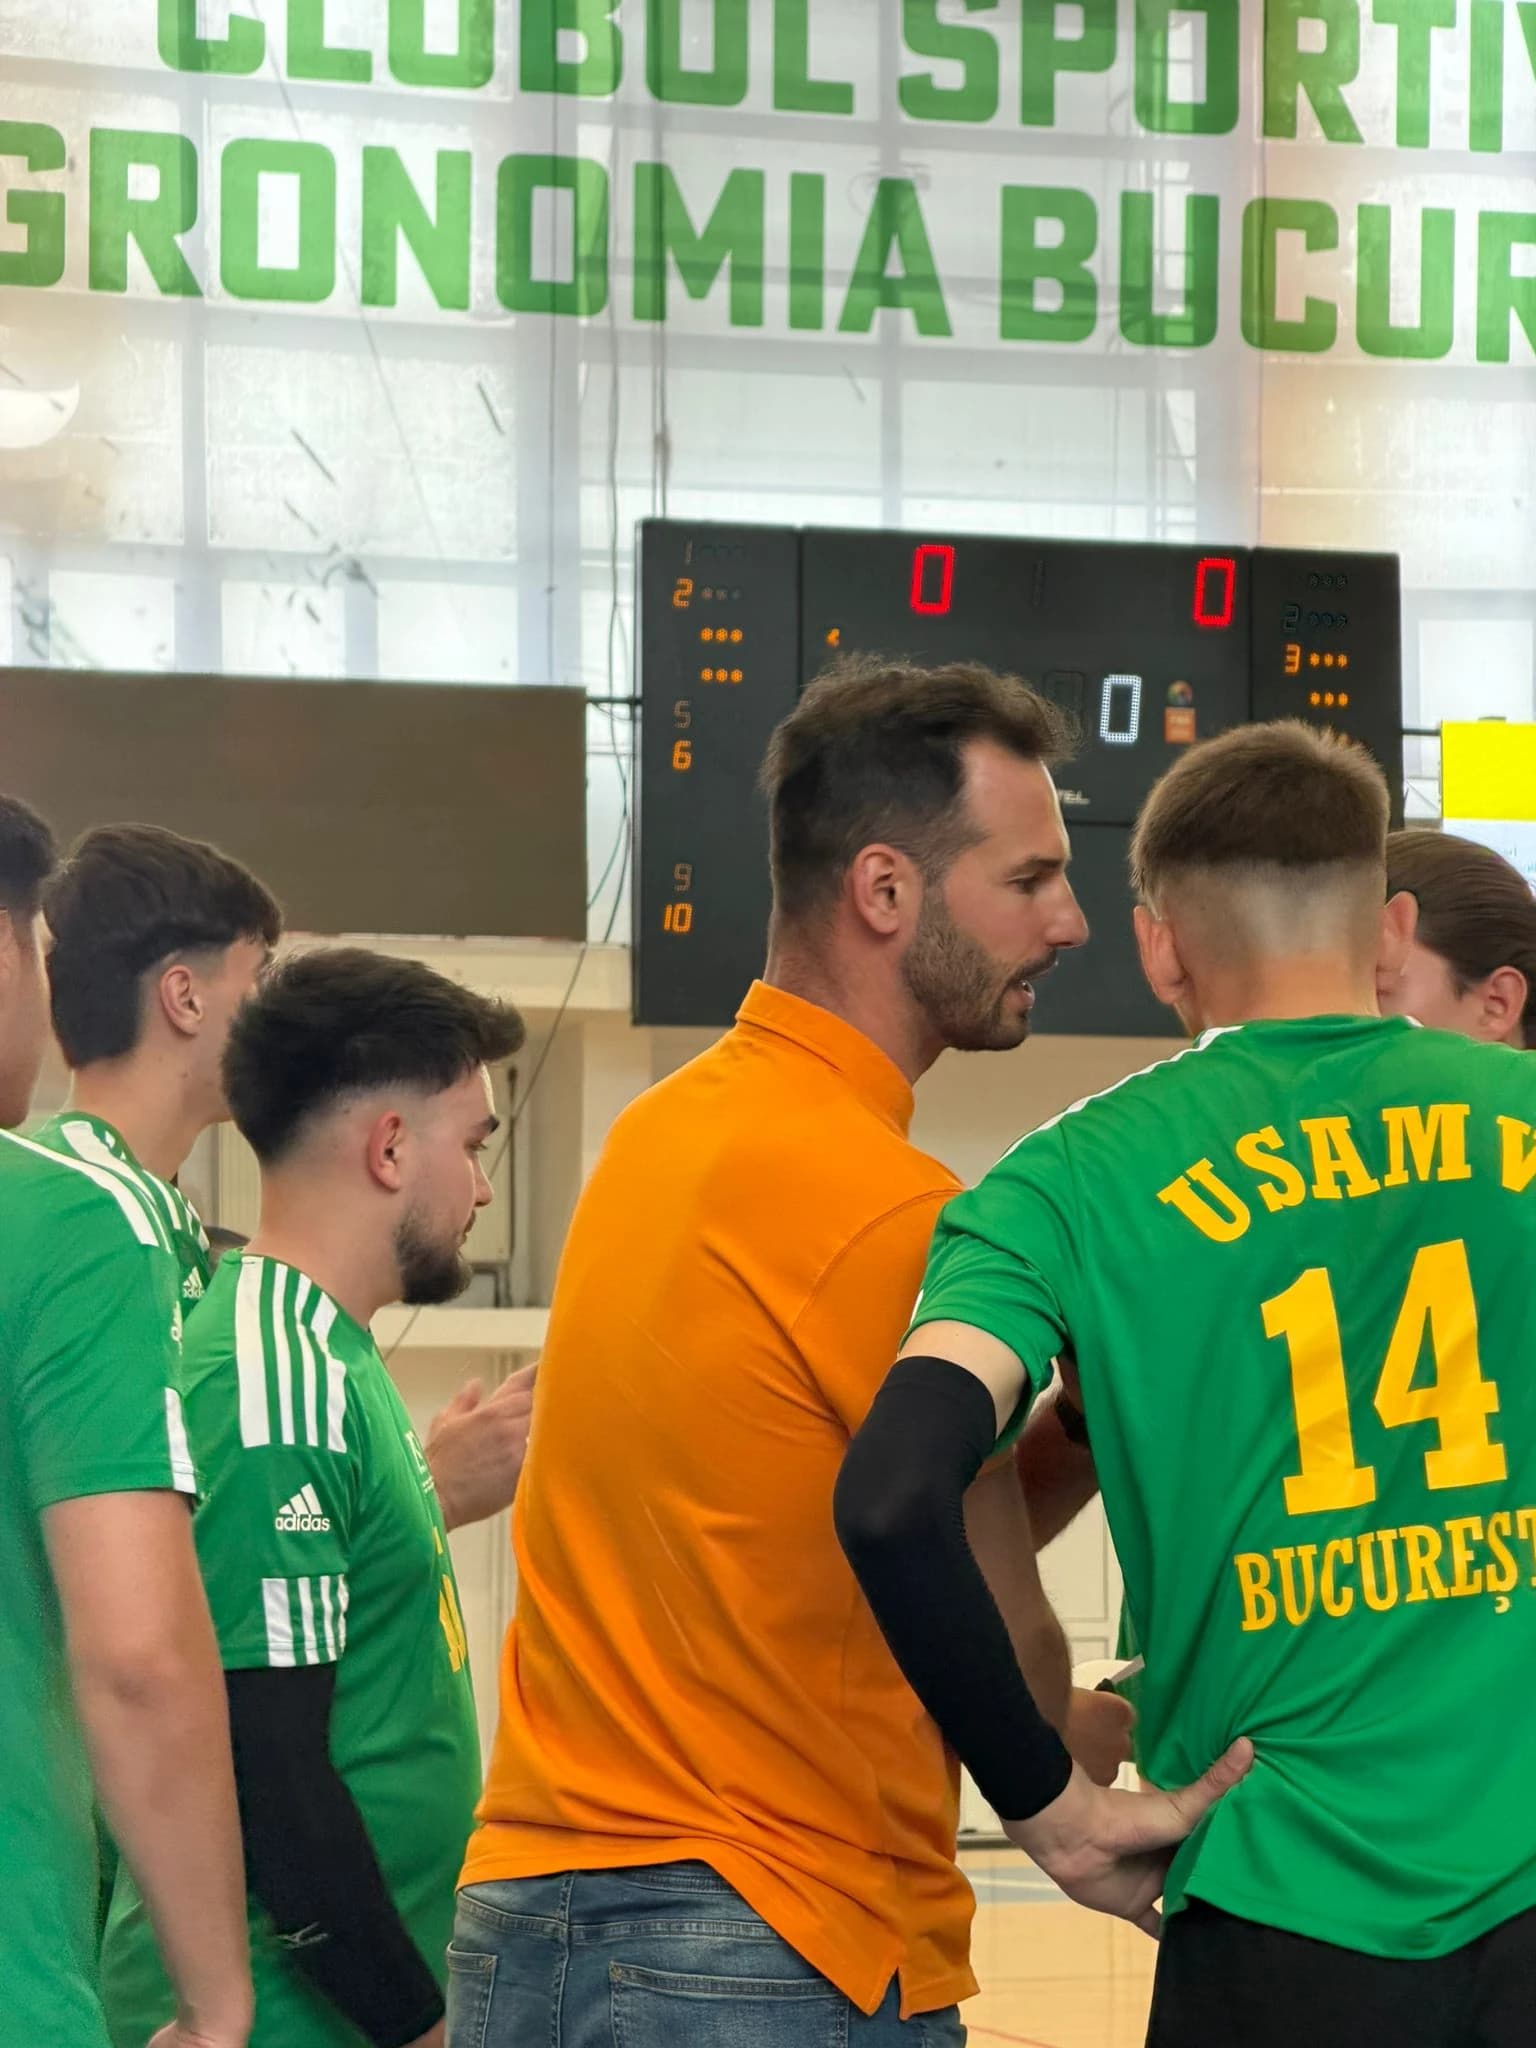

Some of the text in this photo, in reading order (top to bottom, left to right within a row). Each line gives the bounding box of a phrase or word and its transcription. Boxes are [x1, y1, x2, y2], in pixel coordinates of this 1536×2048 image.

[898, 0, 1536, 153] SPORTI
[0, 119, 1536, 364] GRONOMIA BUCUR
[673, 578, 693, 608] 2
[911, 544, 955, 615] 0
[1193, 558, 1236, 627] 0
[1284, 643, 1301, 674] 3
[674, 700, 692, 729] 5
[1100, 674, 1142, 743] 0
[672, 739, 692, 771] 6
[674, 863, 692, 892] 9
[663, 903, 693, 933] 10
[1261, 1238, 1507, 1515] 14
[275, 1512, 331, 1532] adidas
